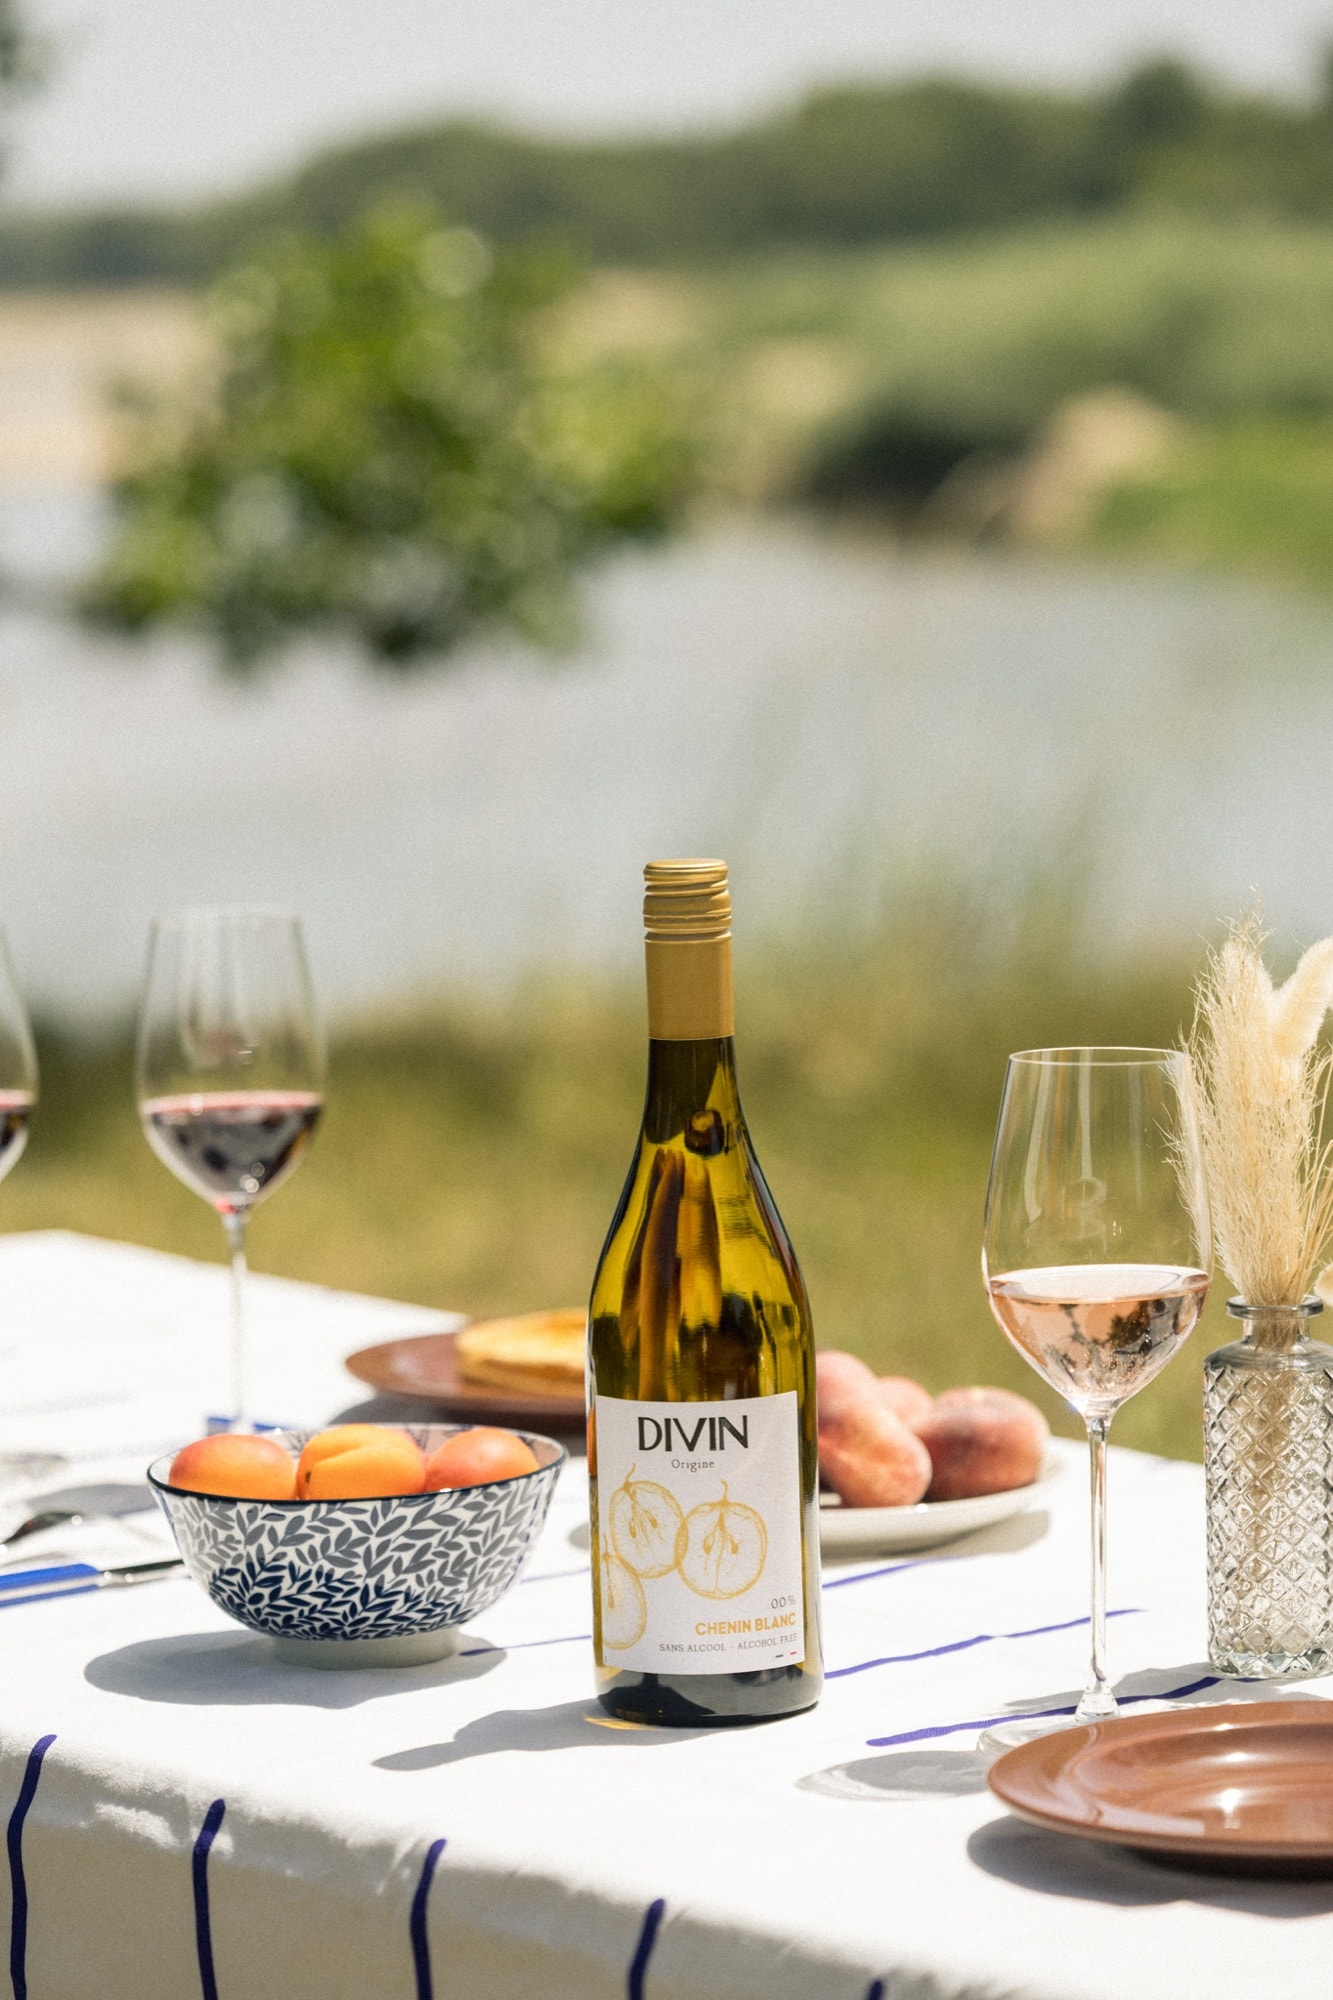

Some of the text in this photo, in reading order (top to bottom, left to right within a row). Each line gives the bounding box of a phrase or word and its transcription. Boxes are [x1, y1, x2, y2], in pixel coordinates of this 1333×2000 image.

[637, 1415, 748, 1452] DIVIN
[671, 1459, 715, 1473] Origine
[695, 1612, 797, 1636] CHENIN BLANC
[659, 1633, 797, 1652] SANS ALCOOL ALCOHOL FREE
